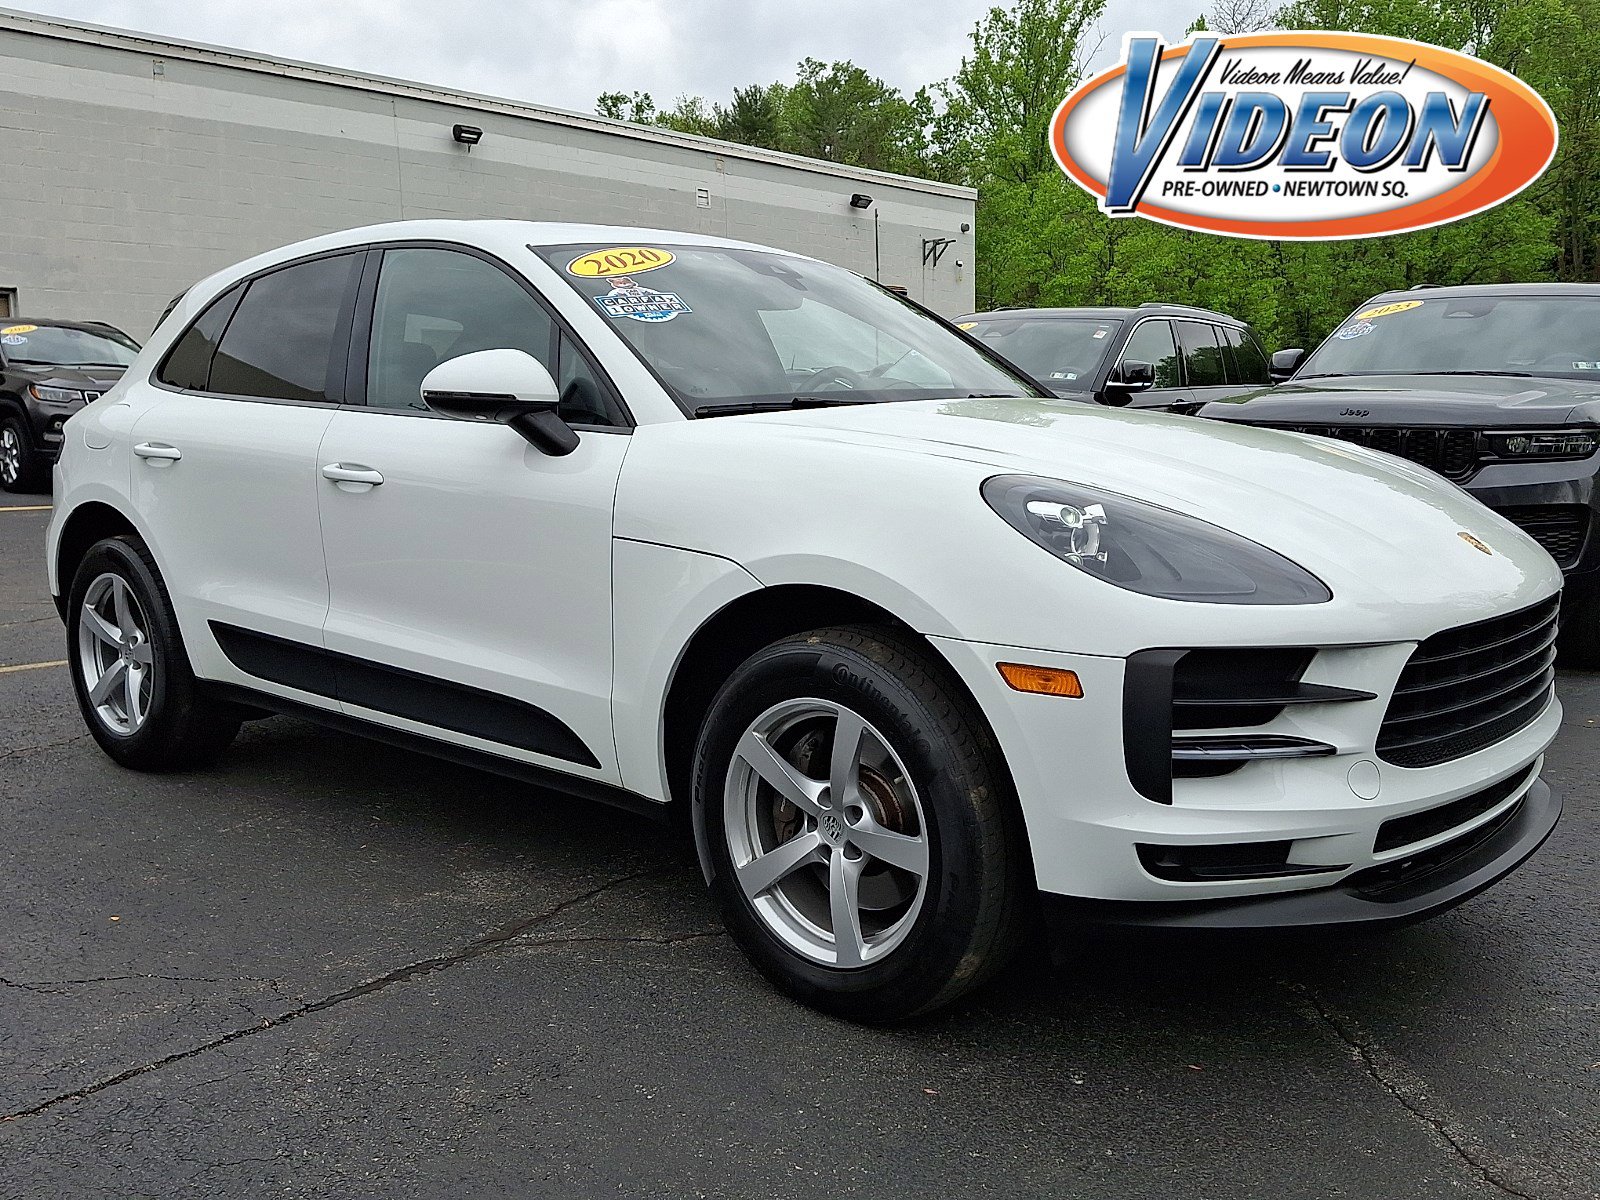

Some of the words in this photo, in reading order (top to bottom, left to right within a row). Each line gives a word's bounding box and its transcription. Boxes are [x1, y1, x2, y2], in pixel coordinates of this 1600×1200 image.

[584, 249, 661, 274] 2020
[604, 296, 677, 306] CARFAX
[1339, 407, 1370, 418] Jeep
